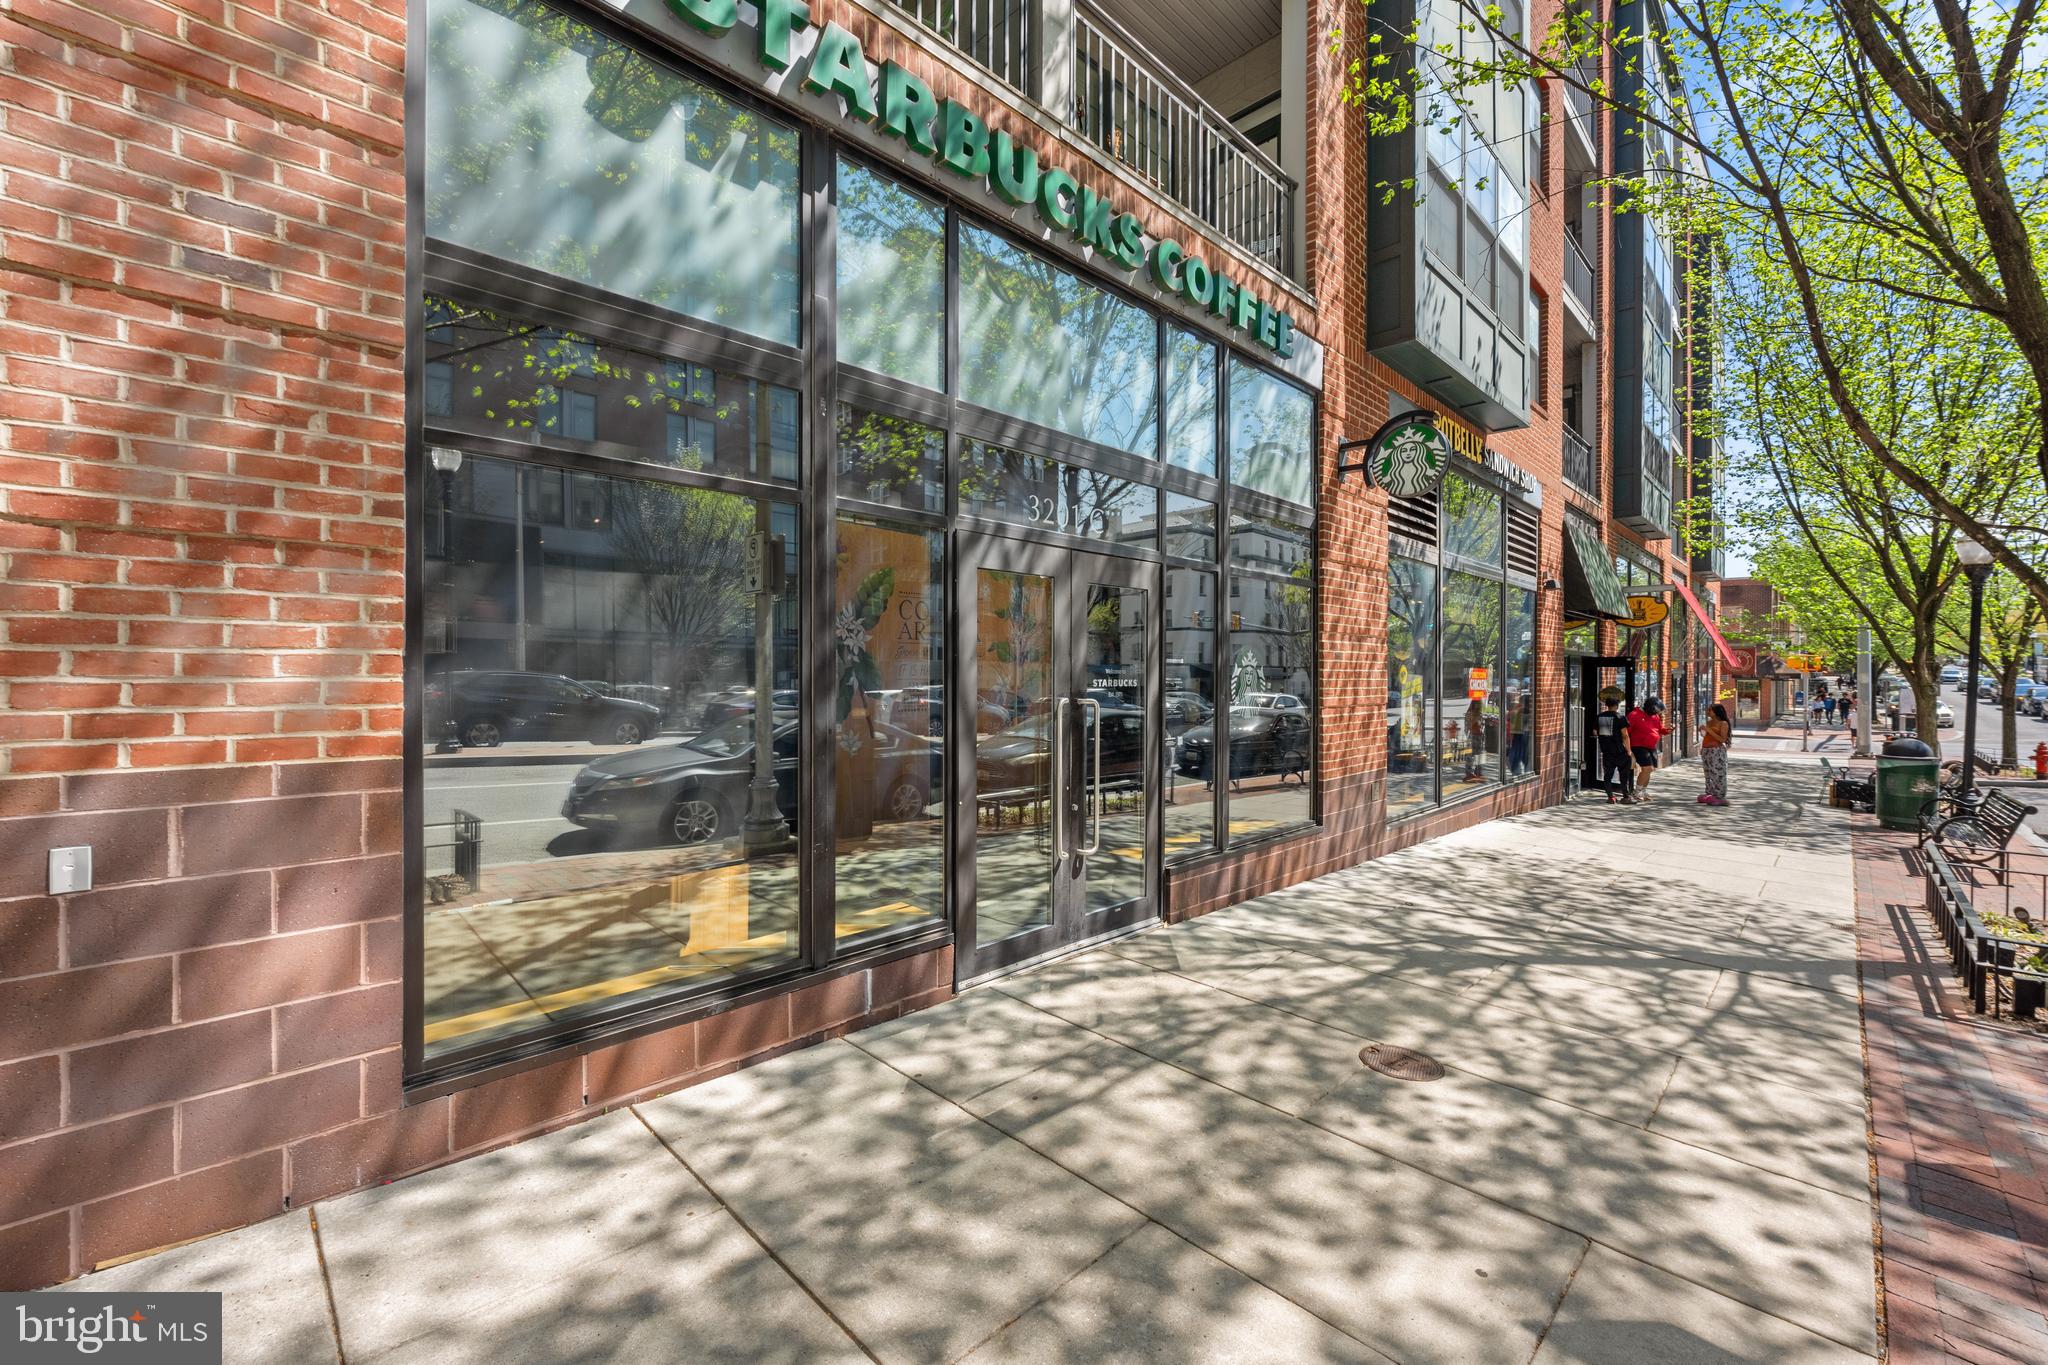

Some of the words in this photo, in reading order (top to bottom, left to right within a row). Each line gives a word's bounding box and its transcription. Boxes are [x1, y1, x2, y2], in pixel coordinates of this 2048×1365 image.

[1149, 239, 1295, 360] COFFEE
[1484, 447, 1520, 485] SANDWICH
[1520, 468, 1537, 493] SHOP
[1092, 678, 1138, 688] STARBUCKS
